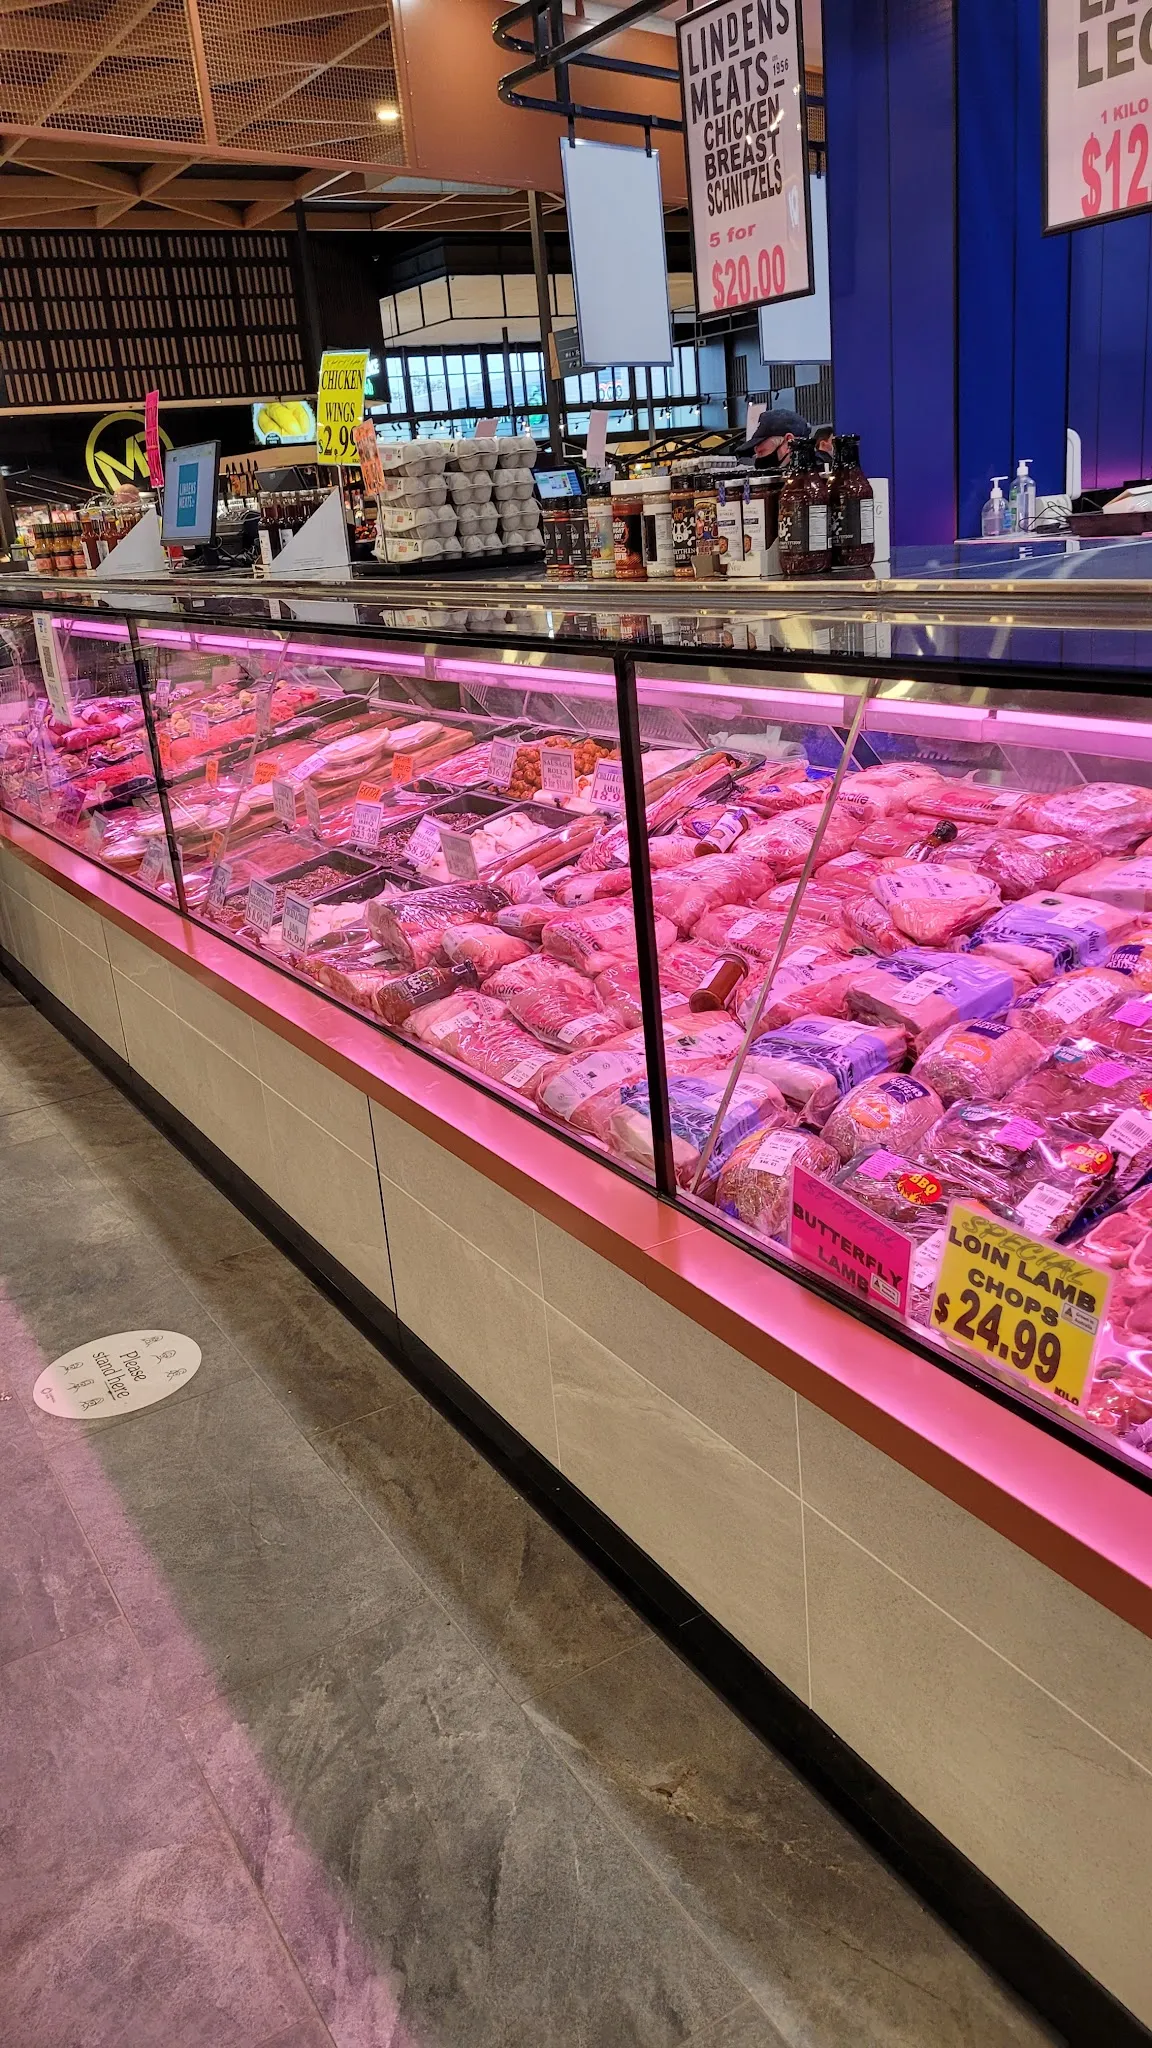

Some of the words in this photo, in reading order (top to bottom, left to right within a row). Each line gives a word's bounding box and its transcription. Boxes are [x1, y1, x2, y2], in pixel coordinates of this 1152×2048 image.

[687, 0, 789, 76] LINDENS
[690, 51, 769, 124] MEATS
[773, 58, 789, 76] 1956
[704, 94, 780, 151] CHICKEN
[1101, 110, 1108, 124] 1
[1113, 98, 1150, 121] KILO
[705, 128, 780, 182] BREAST
[707, 158, 783, 217] SCHNITZELS
[709, 231, 721, 248] 5
[727, 223, 757, 243] for
[711, 244, 786, 310] $20.00
[321, 369, 363, 391] CHICKEN
[325, 402, 356, 423] WINGS
[1076, 1145, 1108, 1165] BBQ
[909, 1173, 938, 1196] BBQ
[793, 1202, 904, 1289] BUTTERFLY
[818, 1245, 869, 1294] LAMB
[948, 1224, 1011, 1271] LOIN
[1016, 1259, 1097, 1314] LAMB
[962, 1215, 1094, 1286] SPECIAL
[967, 1268, 1060, 1328] CHOPS
[934, 1288, 1062, 1384] $24.99
[92, 1351, 123, 1378] stand
[107, 1373, 130, 1399] here
[119, 1350, 147, 1382] Please
[1054, 1386, 1080, 1407] KILO
